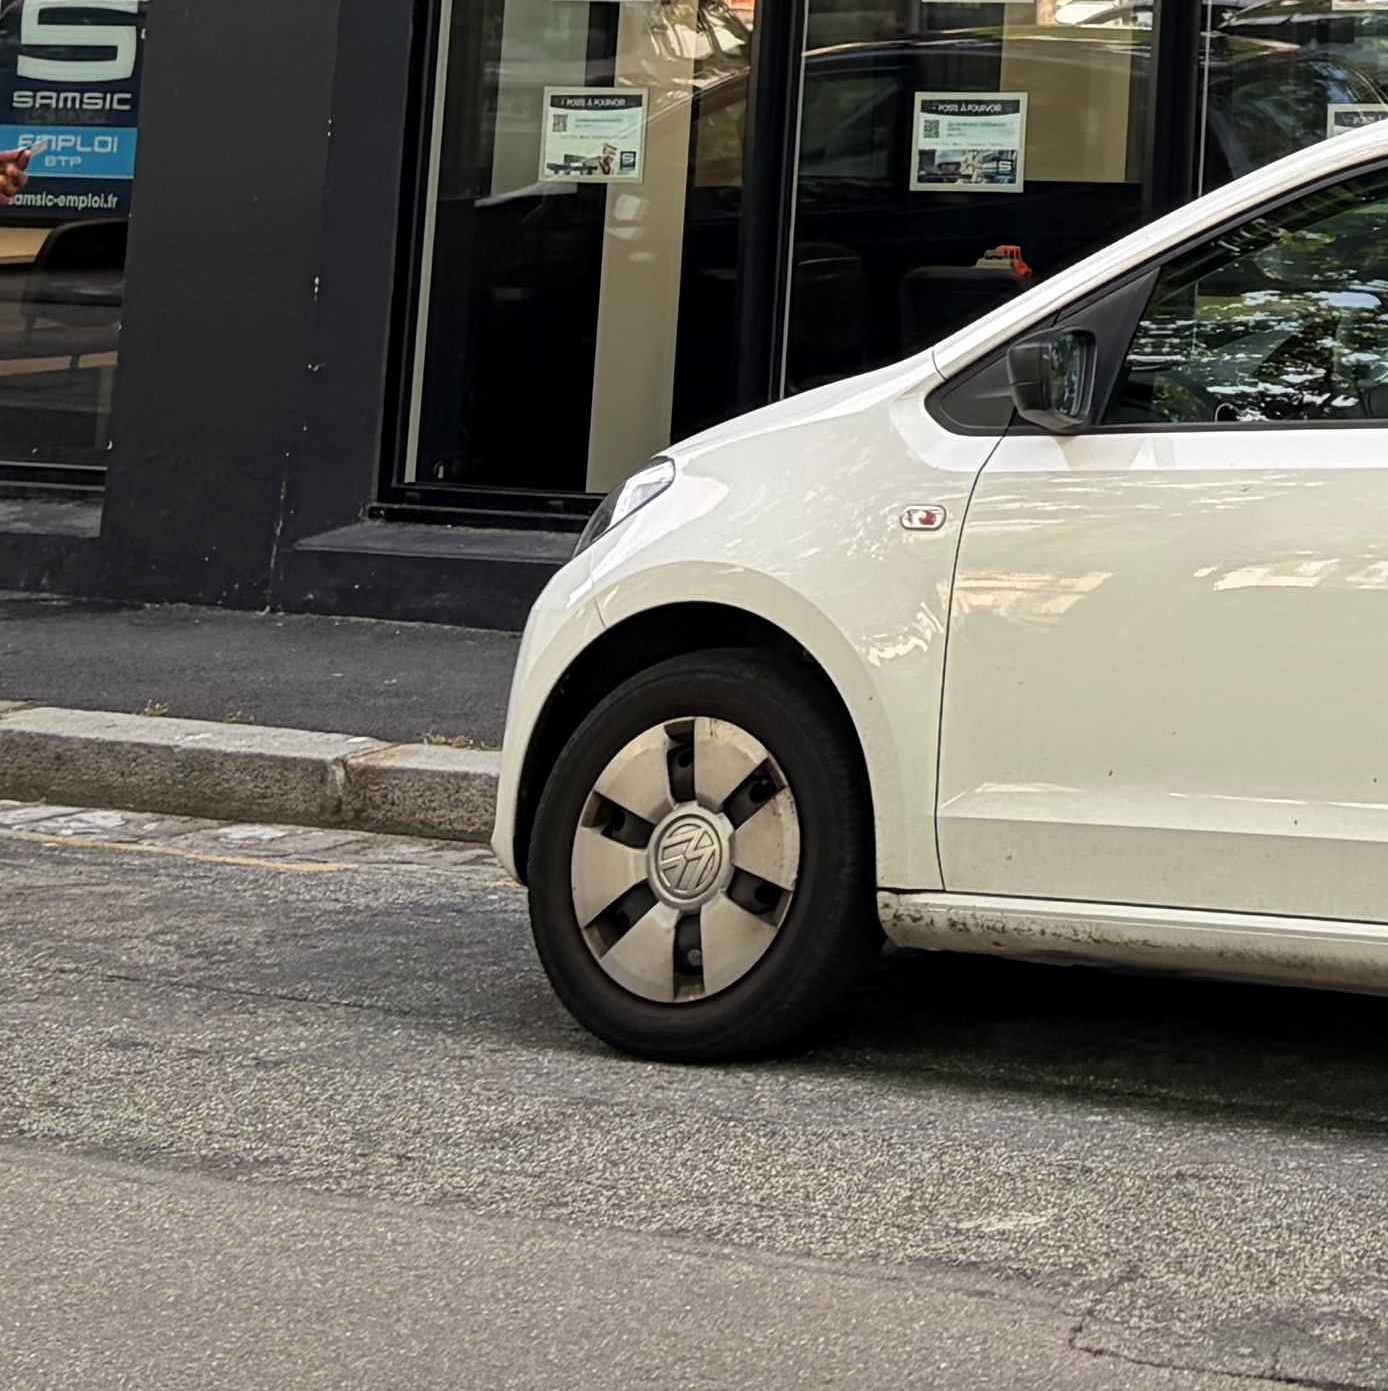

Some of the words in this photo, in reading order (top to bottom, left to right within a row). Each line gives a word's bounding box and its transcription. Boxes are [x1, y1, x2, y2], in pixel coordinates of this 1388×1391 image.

[12, 91, 132, 110] SAMSIC
[17, 134, 118, 154] EMPLOI
[44, 156, 83, 168] BTP
